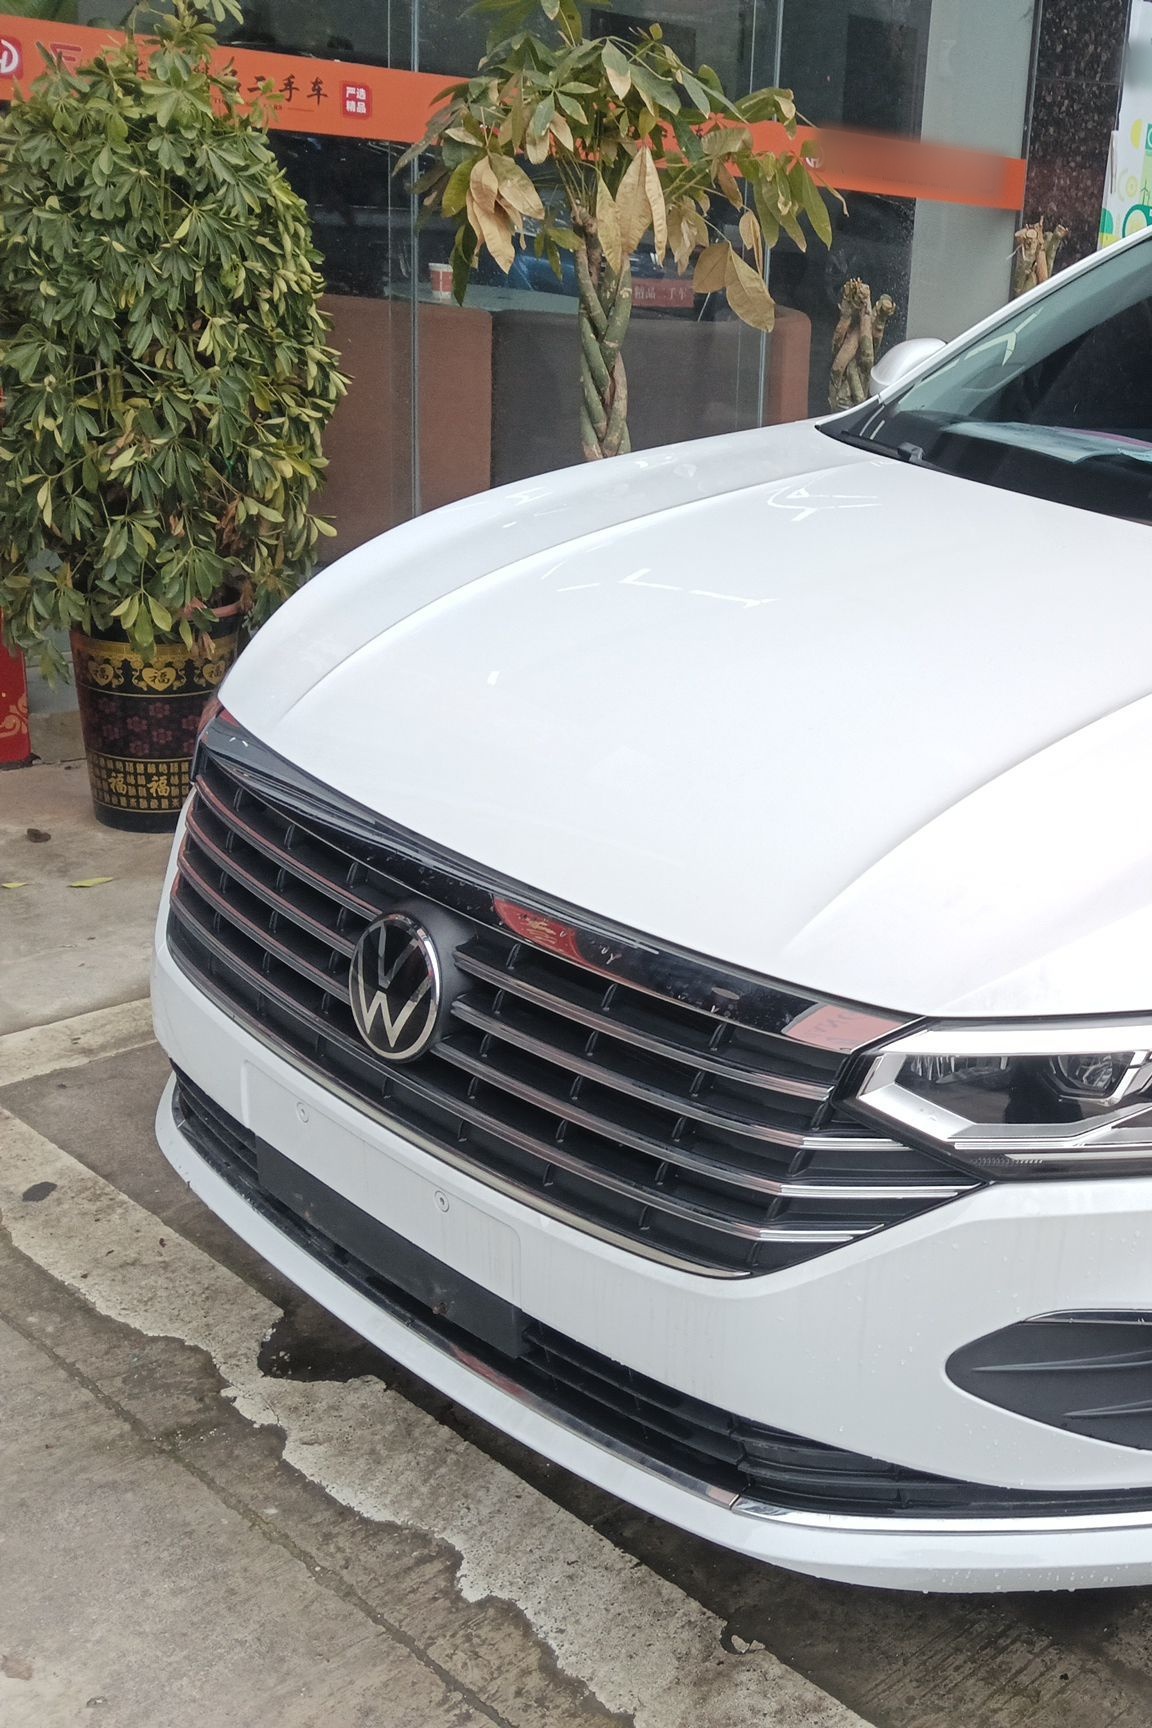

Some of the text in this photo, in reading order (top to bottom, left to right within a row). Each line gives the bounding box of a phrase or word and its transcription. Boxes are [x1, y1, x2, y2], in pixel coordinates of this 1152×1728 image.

[346, 86, 366, 100] 严选
[346, 100, 367, 114] 精品
[148, 668, 170, 684] 福
[108, 774, 128, 795] 福
[147, 775, 171, 797] 福
